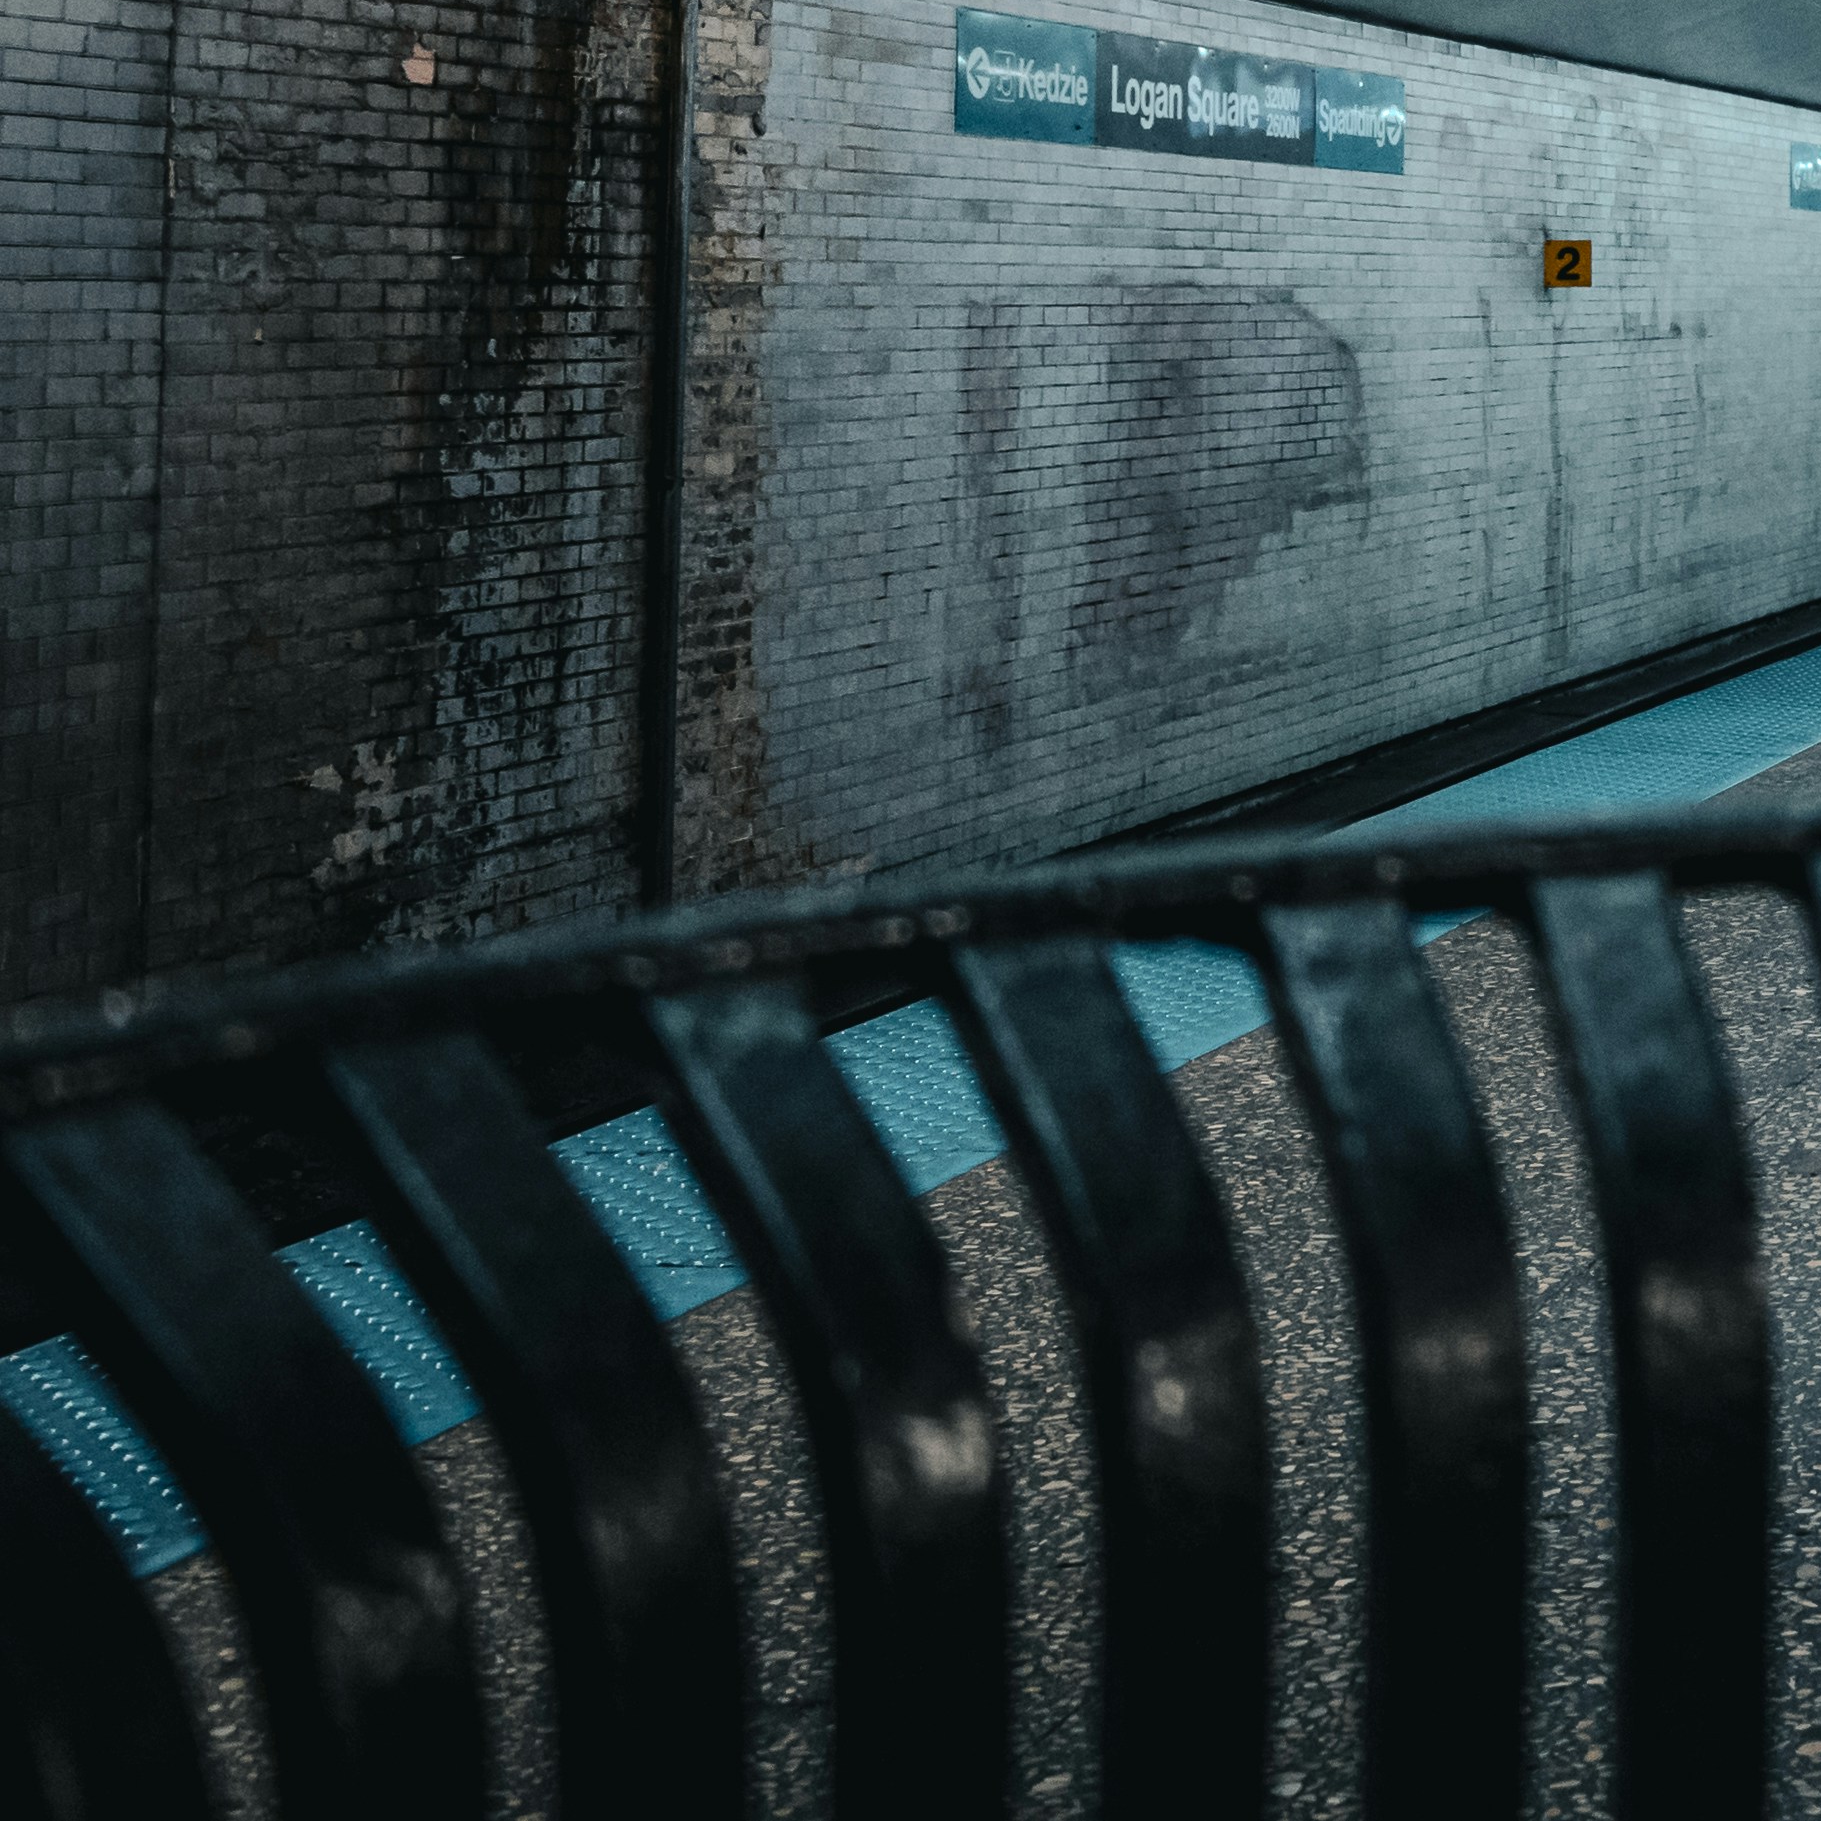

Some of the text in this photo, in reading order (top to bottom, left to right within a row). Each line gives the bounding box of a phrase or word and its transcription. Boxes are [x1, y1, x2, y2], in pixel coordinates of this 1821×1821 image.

[1019, 57, 1088, 106] Kedzie
[1111, 64, 1259, 136] Logan Square
[1264, 84, 1301, 110] 3200W
[1266, 112, 1300, 139] 2600N
[1319, 97, 1385, 147] Spaulding
[1556, 246, 1581, 281] 2
